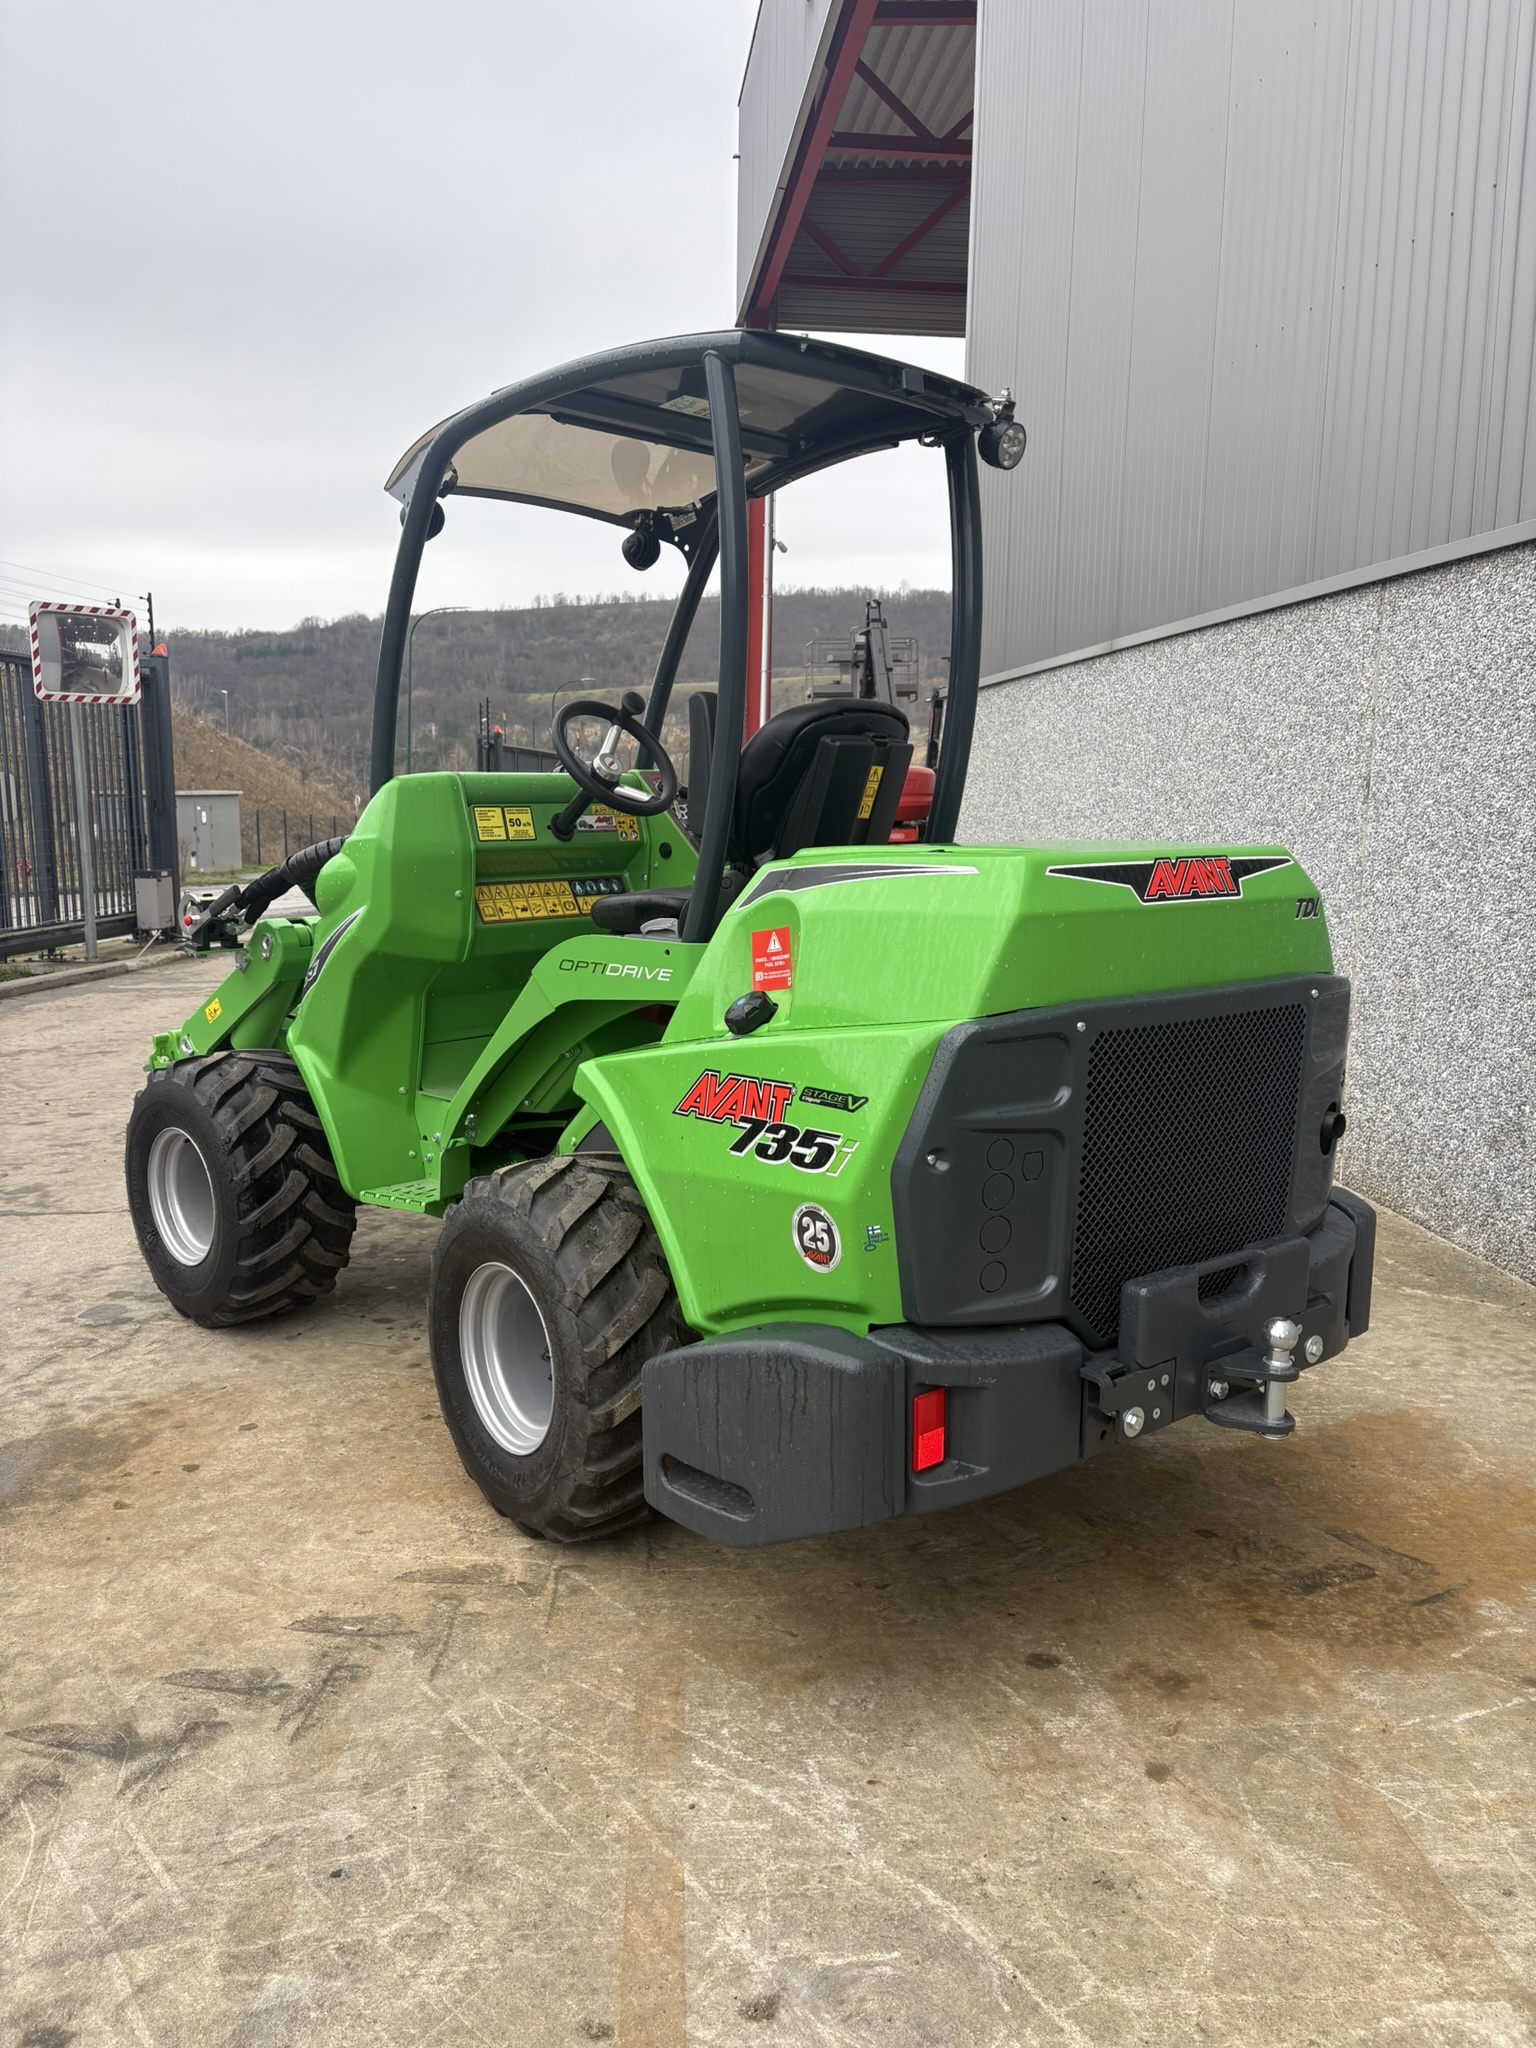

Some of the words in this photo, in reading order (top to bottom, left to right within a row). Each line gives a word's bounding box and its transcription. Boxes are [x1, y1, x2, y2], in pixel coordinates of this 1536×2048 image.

[509, 818, 521, 827] 50
[1145, 857, 1238, 899] AVANT
[558, 958, 674, 982] OPTIDRIVE
[673, 1069, 797, 1127] AVANT
[803, 1088, 848, 1104] STAGE
[848, 1095, 867, 1110] V
[801, 1216, 830, 1253] 25
[804, 1250, 831, 1265] AVANT
